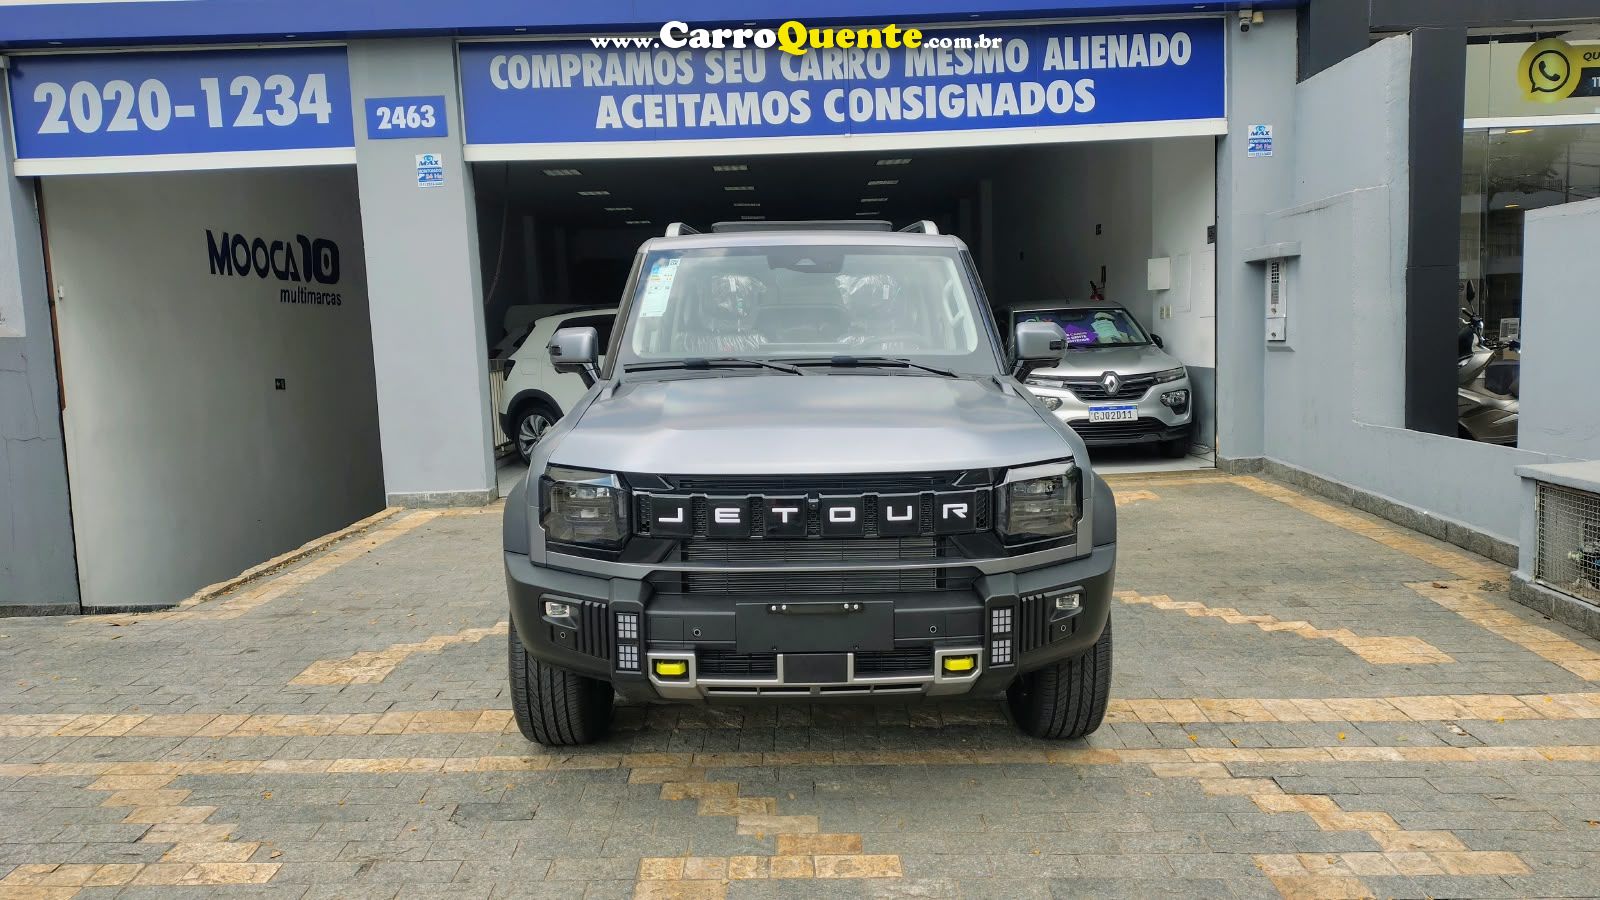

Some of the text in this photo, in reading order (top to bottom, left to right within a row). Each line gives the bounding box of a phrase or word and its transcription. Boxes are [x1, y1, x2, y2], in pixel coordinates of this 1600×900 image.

[489, 31, 1192, 90] COMPRAMOS SEU CARRO MESMO ALIENADO
[33, 73, 332, 135] 2020-1234
[376, 105, 436, 130] 2463
[596, 79, 1097, 129] ACEITAMOS CONSIGNADOS
[280, 286, 342, 306] multimarcas
[658, 503, 968, 524] JETOUR
